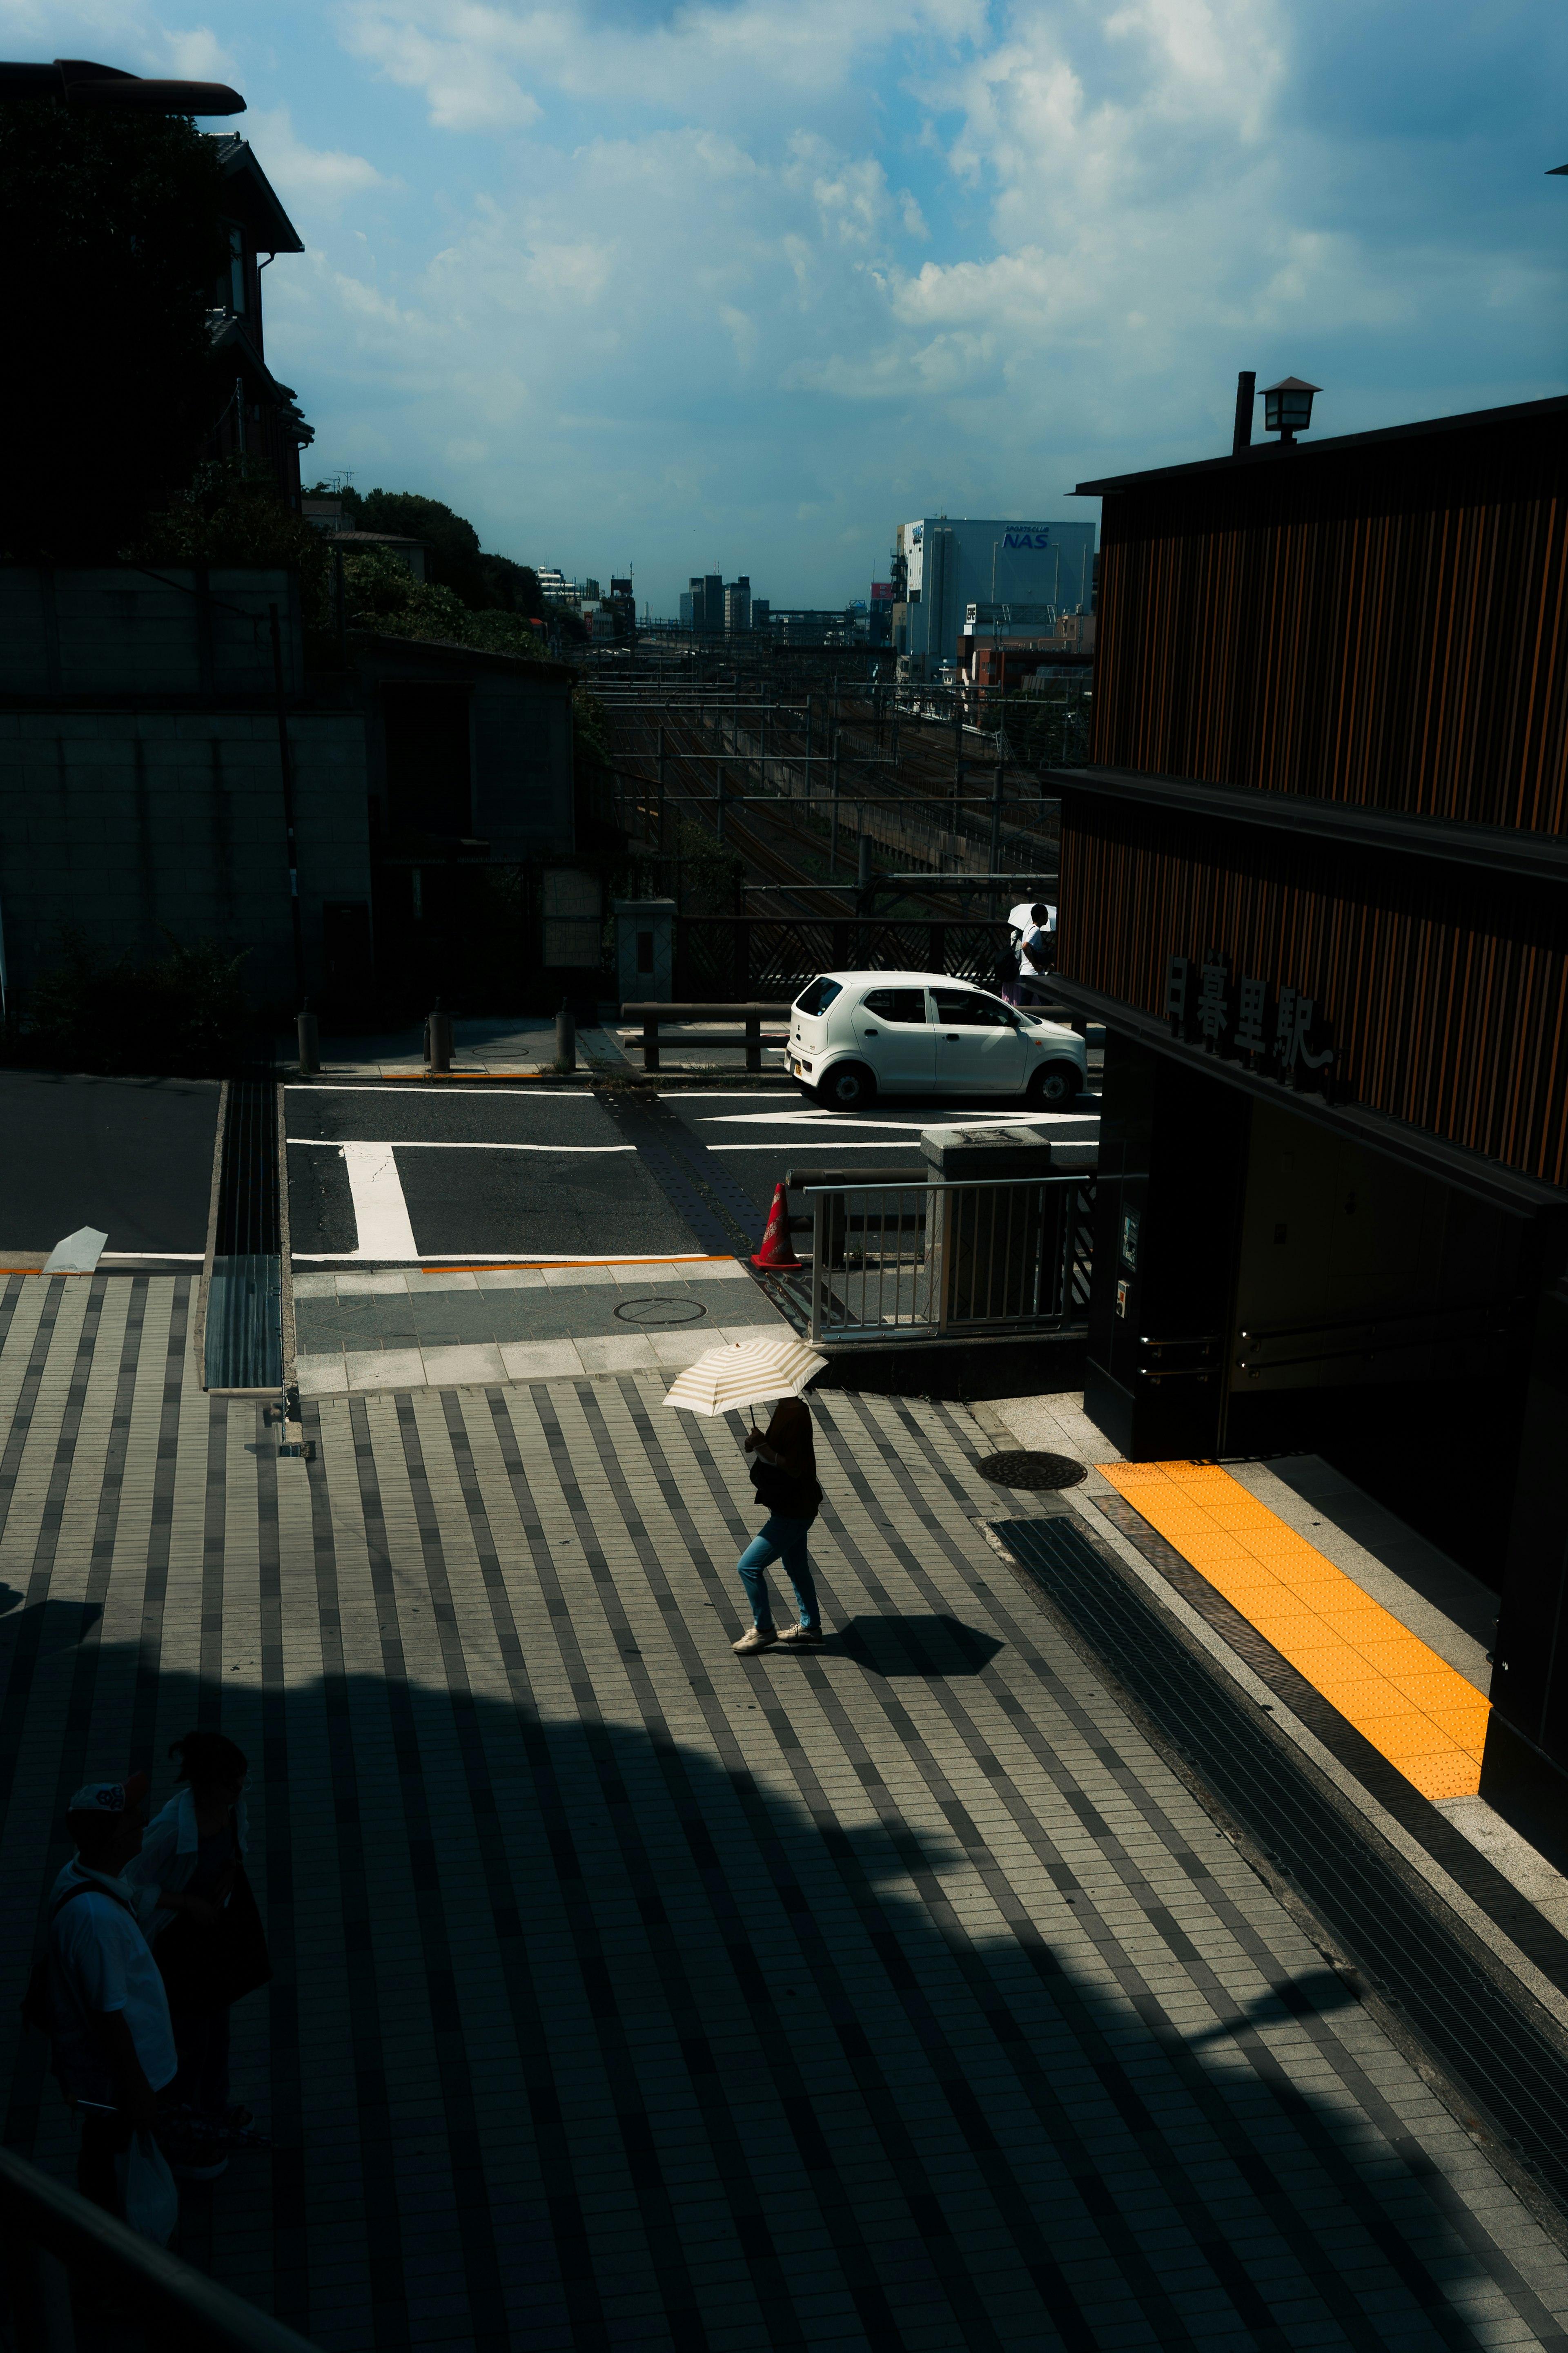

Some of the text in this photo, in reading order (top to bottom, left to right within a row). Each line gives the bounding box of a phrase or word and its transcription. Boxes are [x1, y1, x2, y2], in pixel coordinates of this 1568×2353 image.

[1002, 533, 1048, 549] NAS
[1166, 948, 1333, 1068] 日暮里駅
